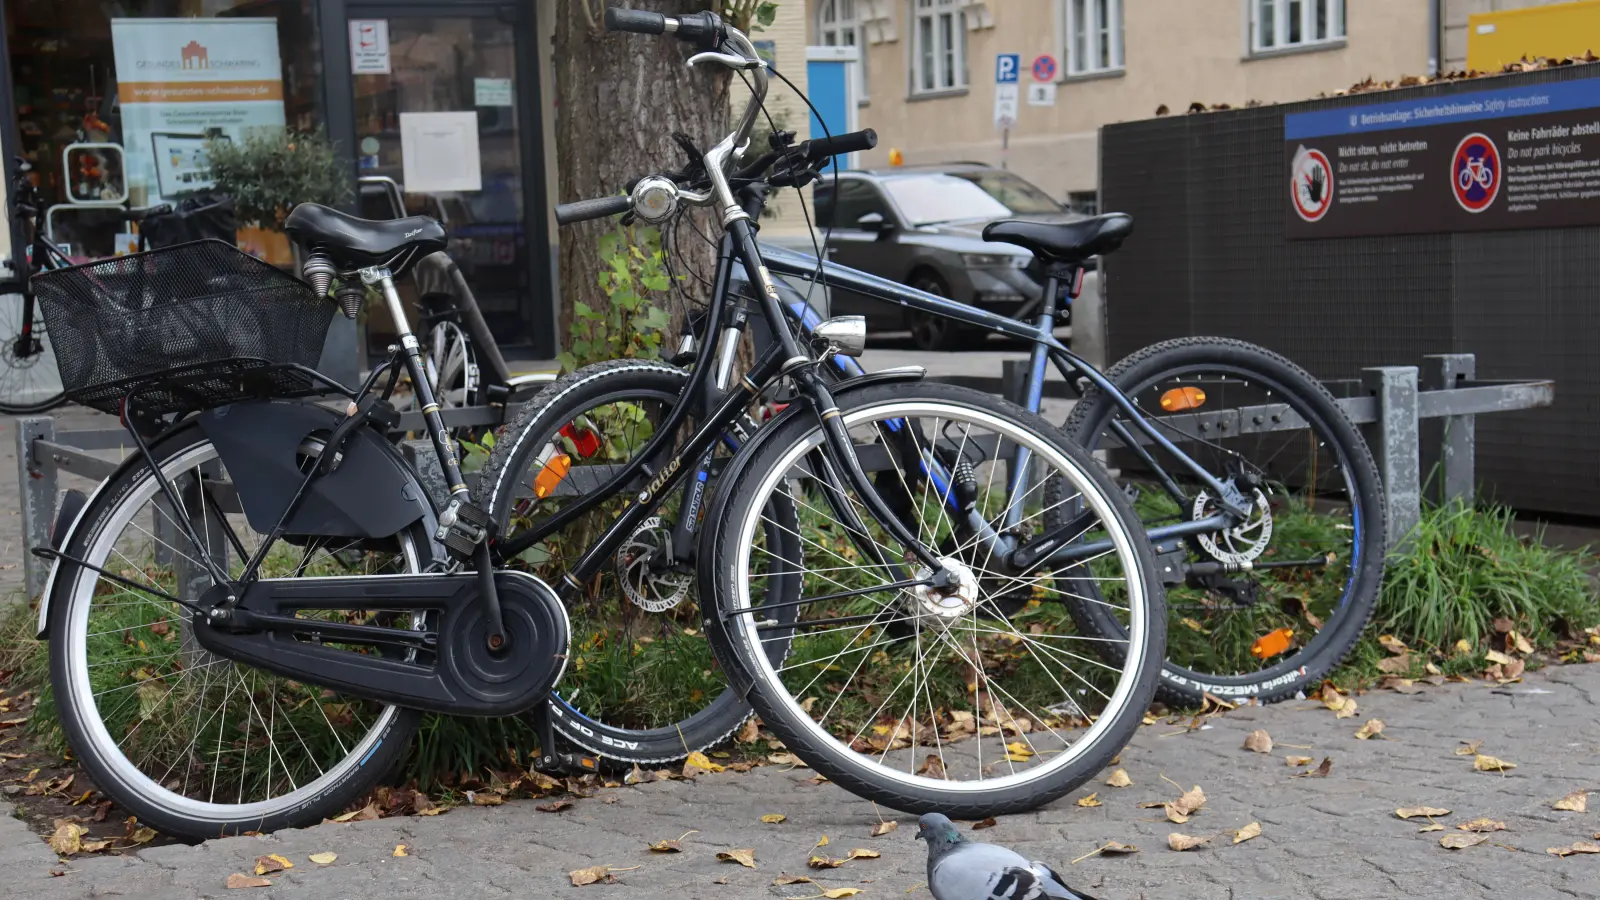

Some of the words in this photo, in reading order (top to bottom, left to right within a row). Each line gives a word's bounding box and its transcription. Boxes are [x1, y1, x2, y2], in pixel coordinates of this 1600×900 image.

[1000, 57, 1014, 80] P
[1361, 109, 1413, 125] Betriebsanlage:
[1413, 101, 1482, 119] Sicherheitshinweise
[1484, 97, 1506, 112] Safety
[1508, 129, 1530, 141] Keine
[1531, 124, 1570, 139] Fahrräder
[1338, 146, 1356, 157] Nicht
[1380, 142, 1397, 153] nicht
[1398, 140, 1428, 152] betreten
[1508, 147, 1519, 159] Do
[1520, 146, 1533, 158] not
[1533, 144, 1550, 159] park
[1552, 141, 1581, 157] bicycles
[1339, 162, 1349, 173] Do
[1349, 162, 1360, 172] not
[1371, 160, 1380, 170] do
[1381, 159, 1392, 169] not
[1261, 666, 1302, 690] vittoria
[1191, 680, 1260, 696] MEZCAL
[570, 720, 593, 738] OF
[601, 734, 638, 750] ACE
[323, 764, 360, 796] MARATHON
[300, 796, 321, 810] PLUS
